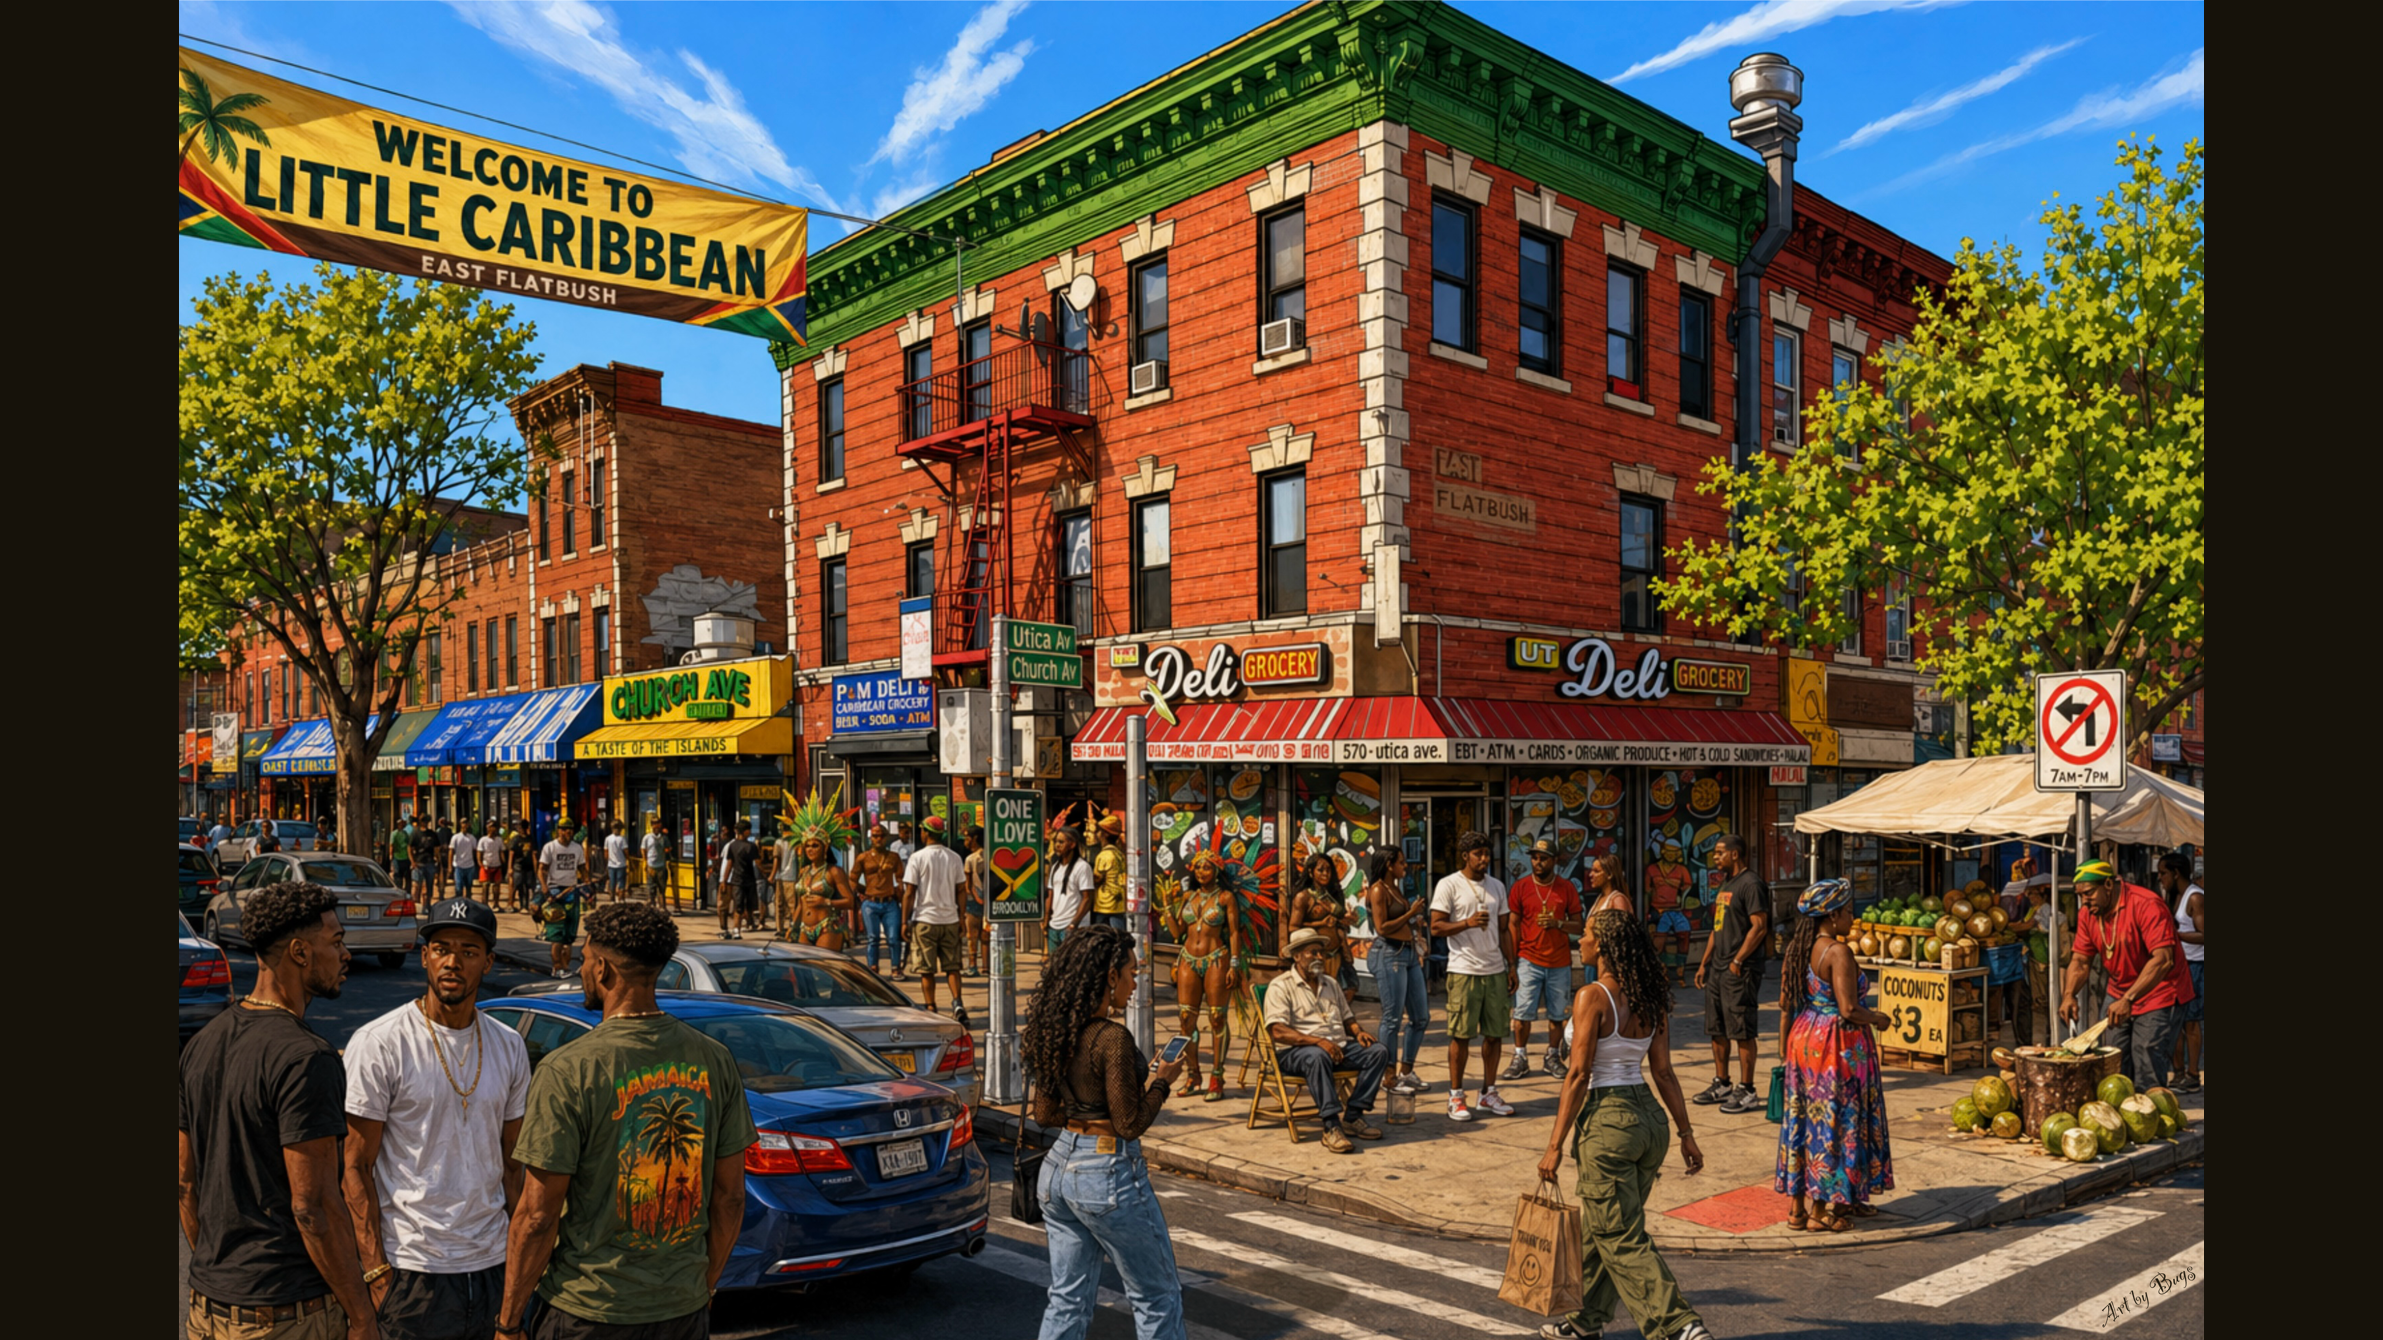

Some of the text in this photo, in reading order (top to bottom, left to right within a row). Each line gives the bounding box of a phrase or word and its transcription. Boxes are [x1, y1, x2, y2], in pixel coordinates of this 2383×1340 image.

[372, 120, 654, 219] WELCOME TO
[243, 147, 766, 300] LITTLE CARIBBEAN
[421, 255, 617, 305] EAST FLATBUSH
[1435, 448, 1480, 483] EAST
[1437, 489, 1529, 524] FLATBUSH
[1012, 625, 1072, 651] Utica Av
[1520, 642, 1556, 663] UT
[1012, 656, 1078, 681] Church Av
[1140, 643, 1238, 702] Deli
[1245, 650, 1319, 680] GROCERY
[1561, 638, 1670, 699] Deli
[1678, 664, 1746, 690] GROCERY
[611, 669, 751, 721] CHURCH AVE
[877, 678, 912, 698] DELI
[582, 737, 727, 756] A TASTE OF THE ISLANDS
[1413, 744, 1442, 759] ave.
[1455, 743, 1478, 760] EBT
[1487, 743, 1515, 760] ATM
[1528, 744, 1566, 761] CARDS
[1575, 744, 1621, 761] ORGANIC
[1623, 745, 1672, 762] PRODUCE
[995, 798, 1033, 819] ONE
[993, 822, 1037, 843] LOVE
[1883, 975, 1945, 1003] COCONUTS
[1891, 1004, 1943, 1045] $3 EA
[611, 1061, 712, 1121] JAMAICA
